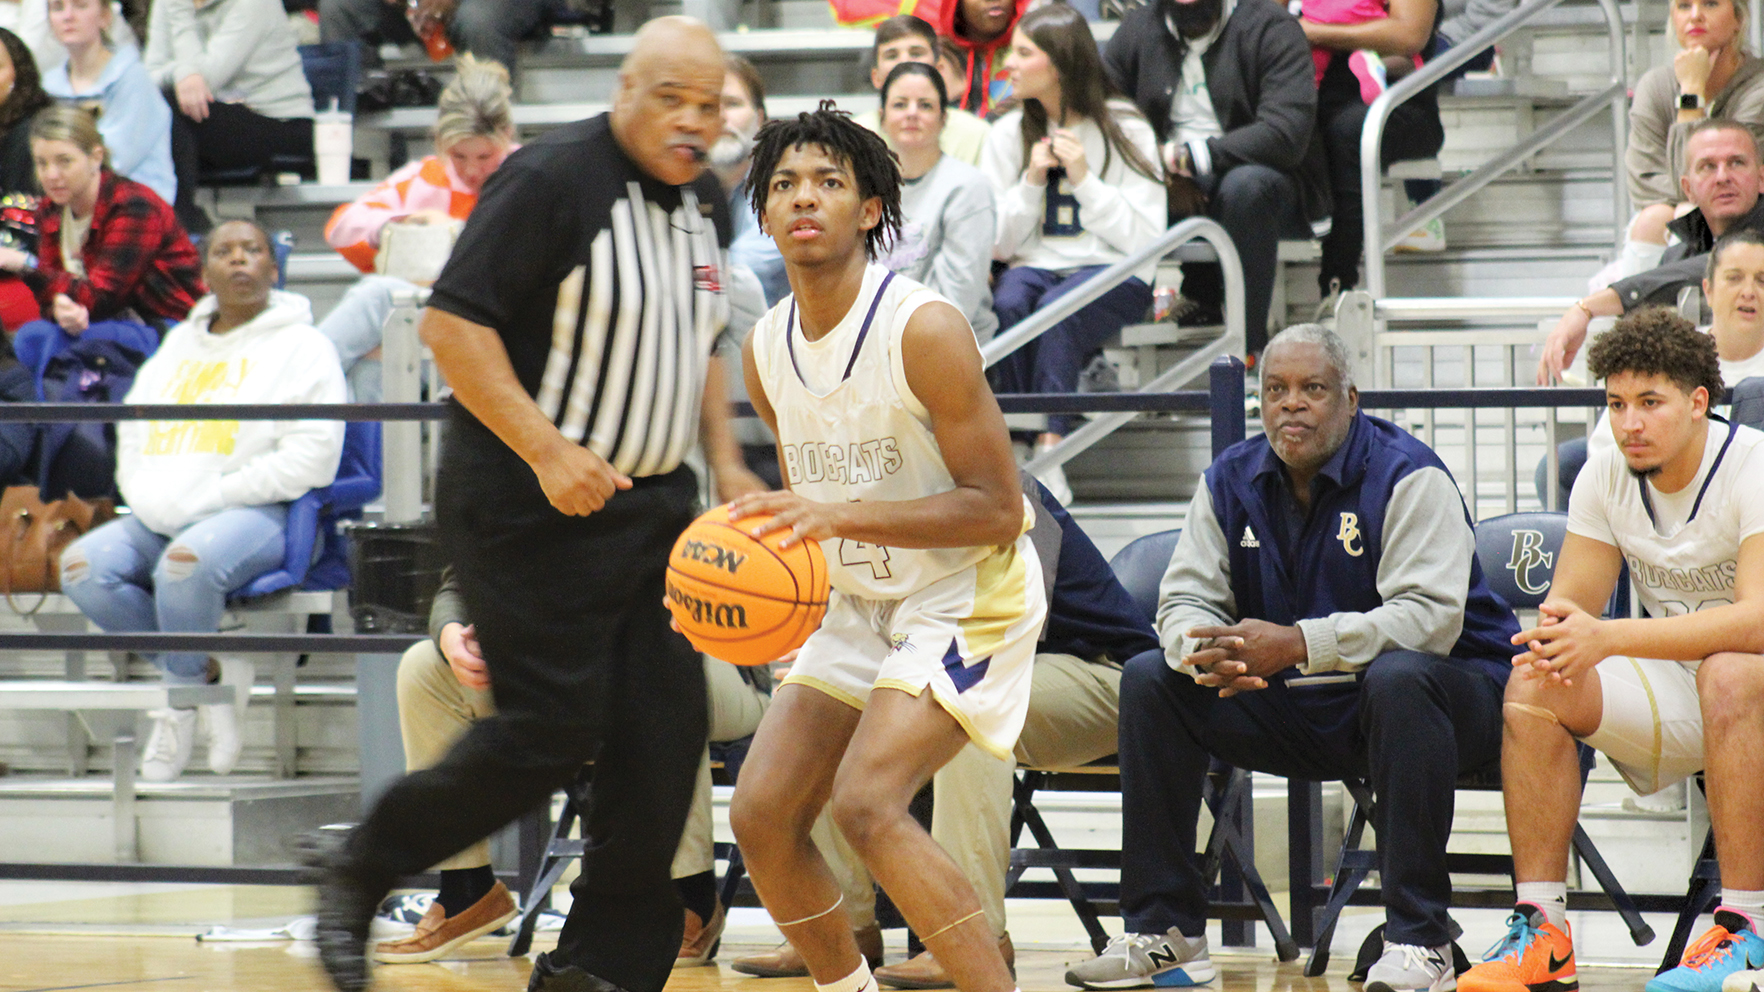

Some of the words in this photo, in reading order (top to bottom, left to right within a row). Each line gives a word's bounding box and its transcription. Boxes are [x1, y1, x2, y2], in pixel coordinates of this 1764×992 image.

[783, 436, 904, 486] BOBCATS
[681, 538, 749, 574] NCAA
[1336, 511, 1364, 557] BC
[1505, 529, 1553, 595] BC
[667, 577, 748, 629] Wilson
